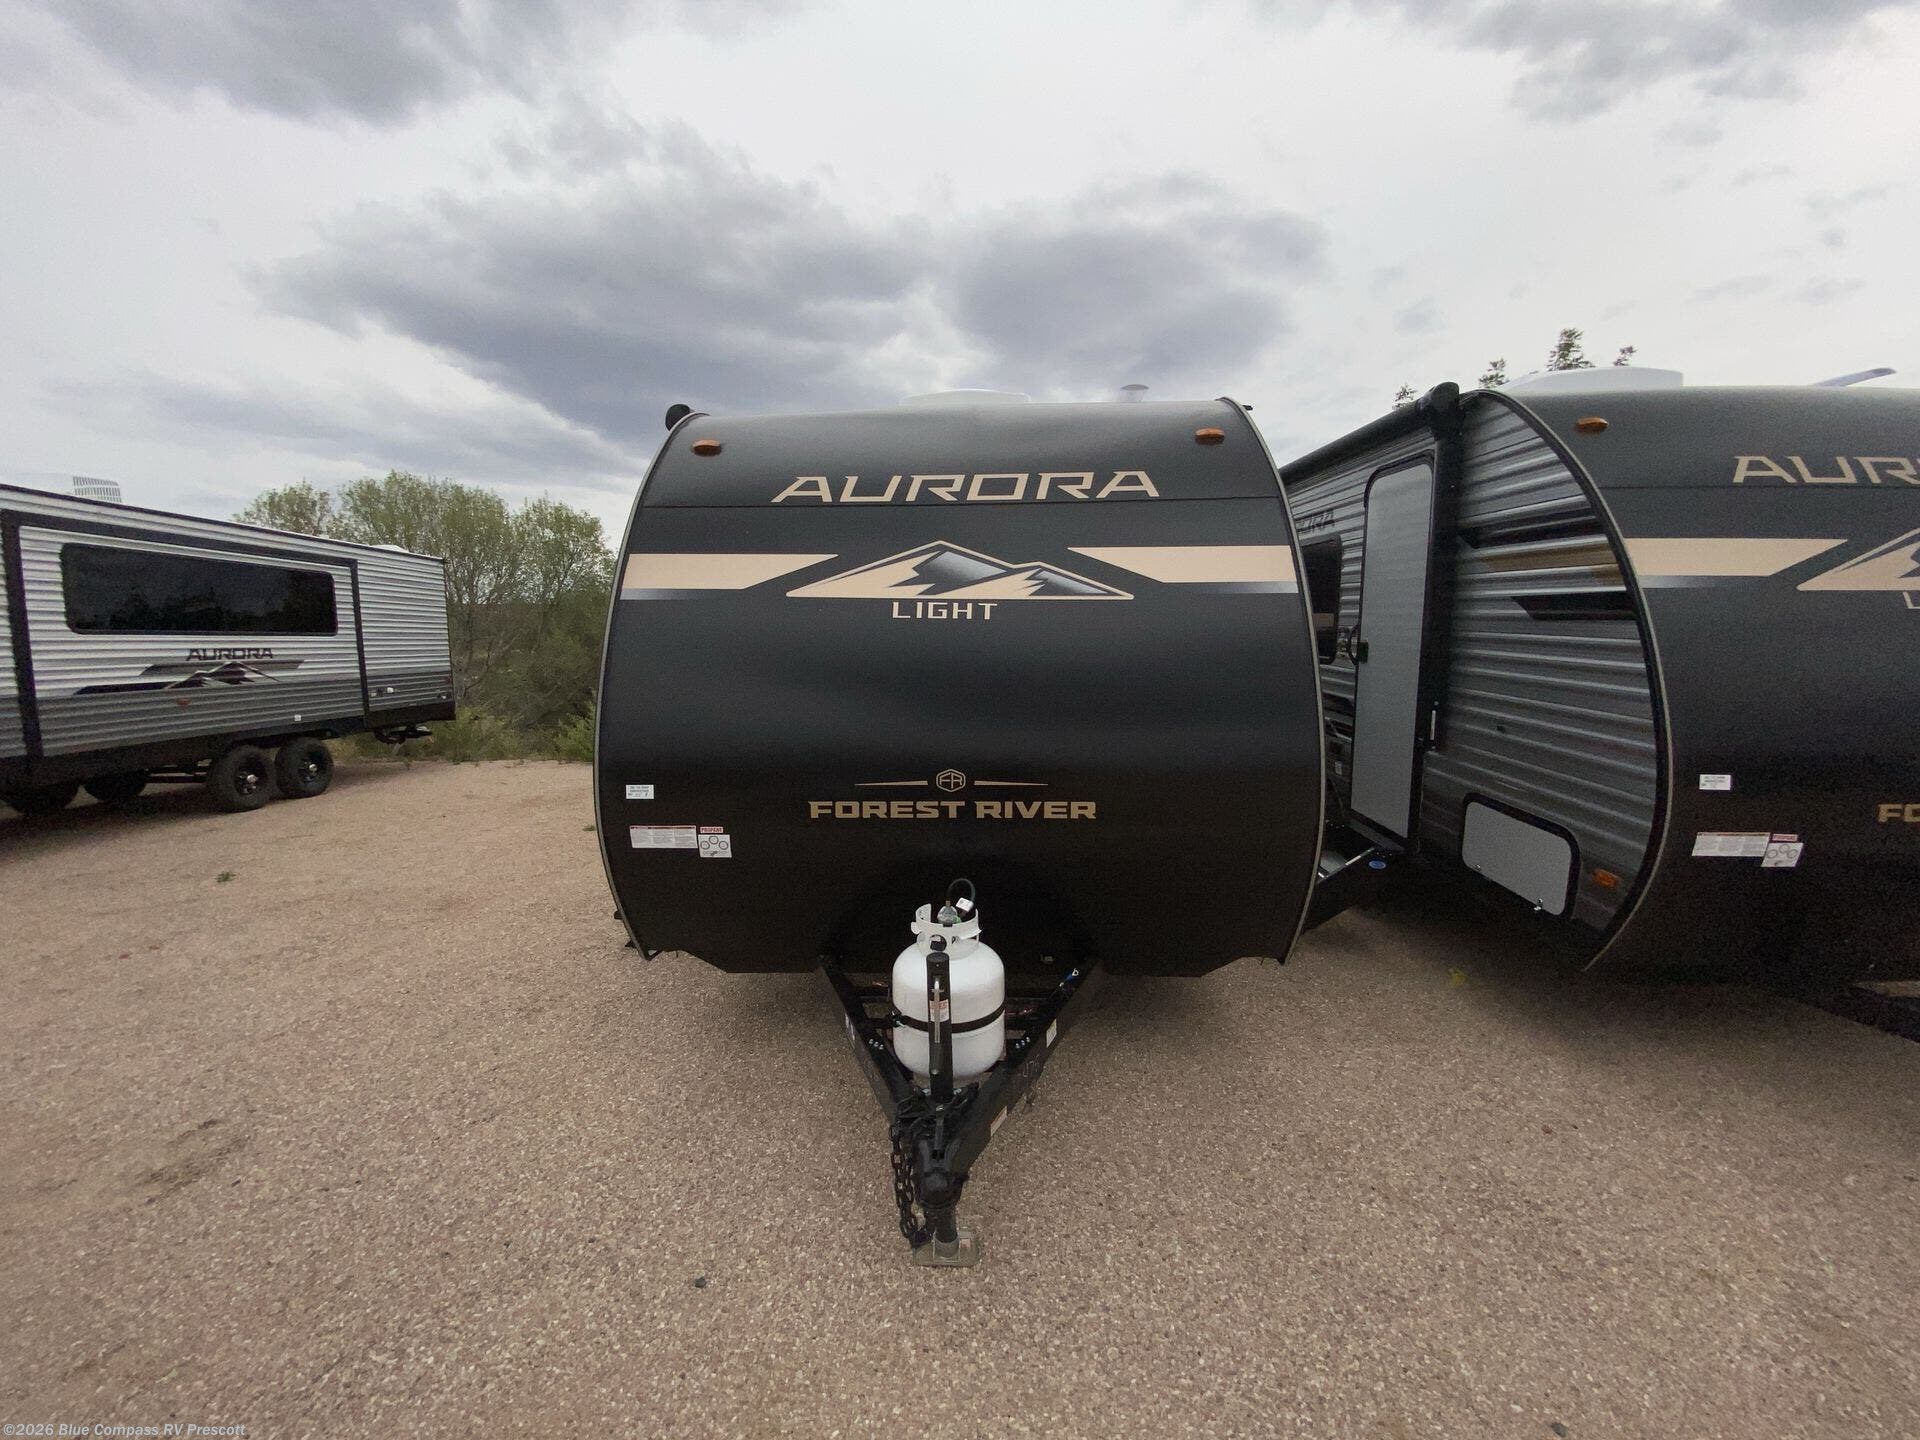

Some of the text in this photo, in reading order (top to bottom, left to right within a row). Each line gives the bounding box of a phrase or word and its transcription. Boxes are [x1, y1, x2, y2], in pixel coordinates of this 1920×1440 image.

[1733, 456, 1920, 485] AUR
[771, 470, 1160, 503] AURORA
[892, 601, 998, 620] LIGHT
[186, 648, 273, 661] AURORA
[808, 801, 1097, 819] FOREST RIVER
